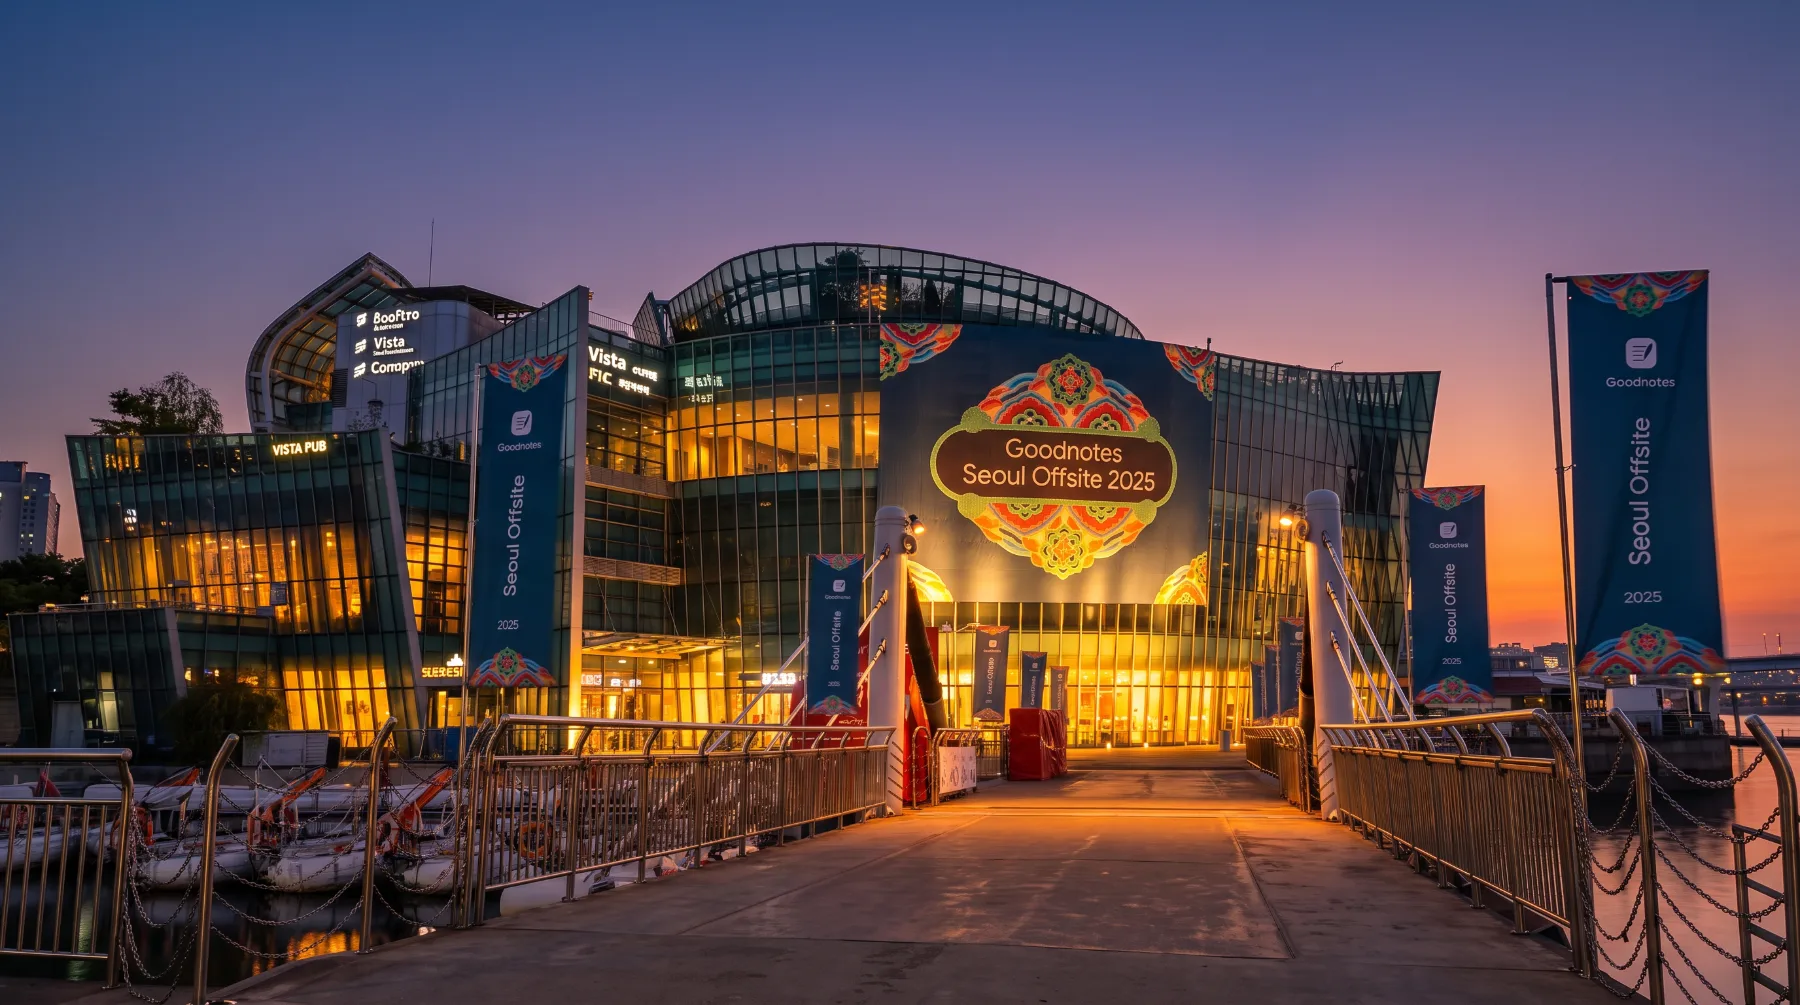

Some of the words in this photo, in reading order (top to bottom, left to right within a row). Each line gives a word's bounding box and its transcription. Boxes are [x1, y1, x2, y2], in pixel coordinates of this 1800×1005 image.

[373, 336, 405, 350] Vista
[588, 345, 627, 371] Vista
[1606, 376, 1675, 388] Goodnotes
[272, 442, 303, 456] VISTA
[304, 440, 327, 453] PUB
[497, 441, 542, 452] Goodnotes
[1005, 437, 1123, 463] Goodnotes
[1629, 417, 1651, 495] Offsite
[963, 463, 1026, 486] Seoul
[1032, 465, 1103, 489] Offsite
[1107, 470, 1156, 492] 2025
[507, 474, 525, 539] Offsite
[1628, 501, 1651, 565] Seoul
[503, 544, 520, 596] Seoul
[1443, 563, 1456, 606] Offsite
[1623, 591, 1663, 604] 2025
[497, 619, 519, 630] 2025
[831, 610, 842, 643] Offsite
[1444, 608, 1457, 643] Seoul
[830, 645, 841, 671] Seoul
[1442, 657, 1462, 665] 2025
